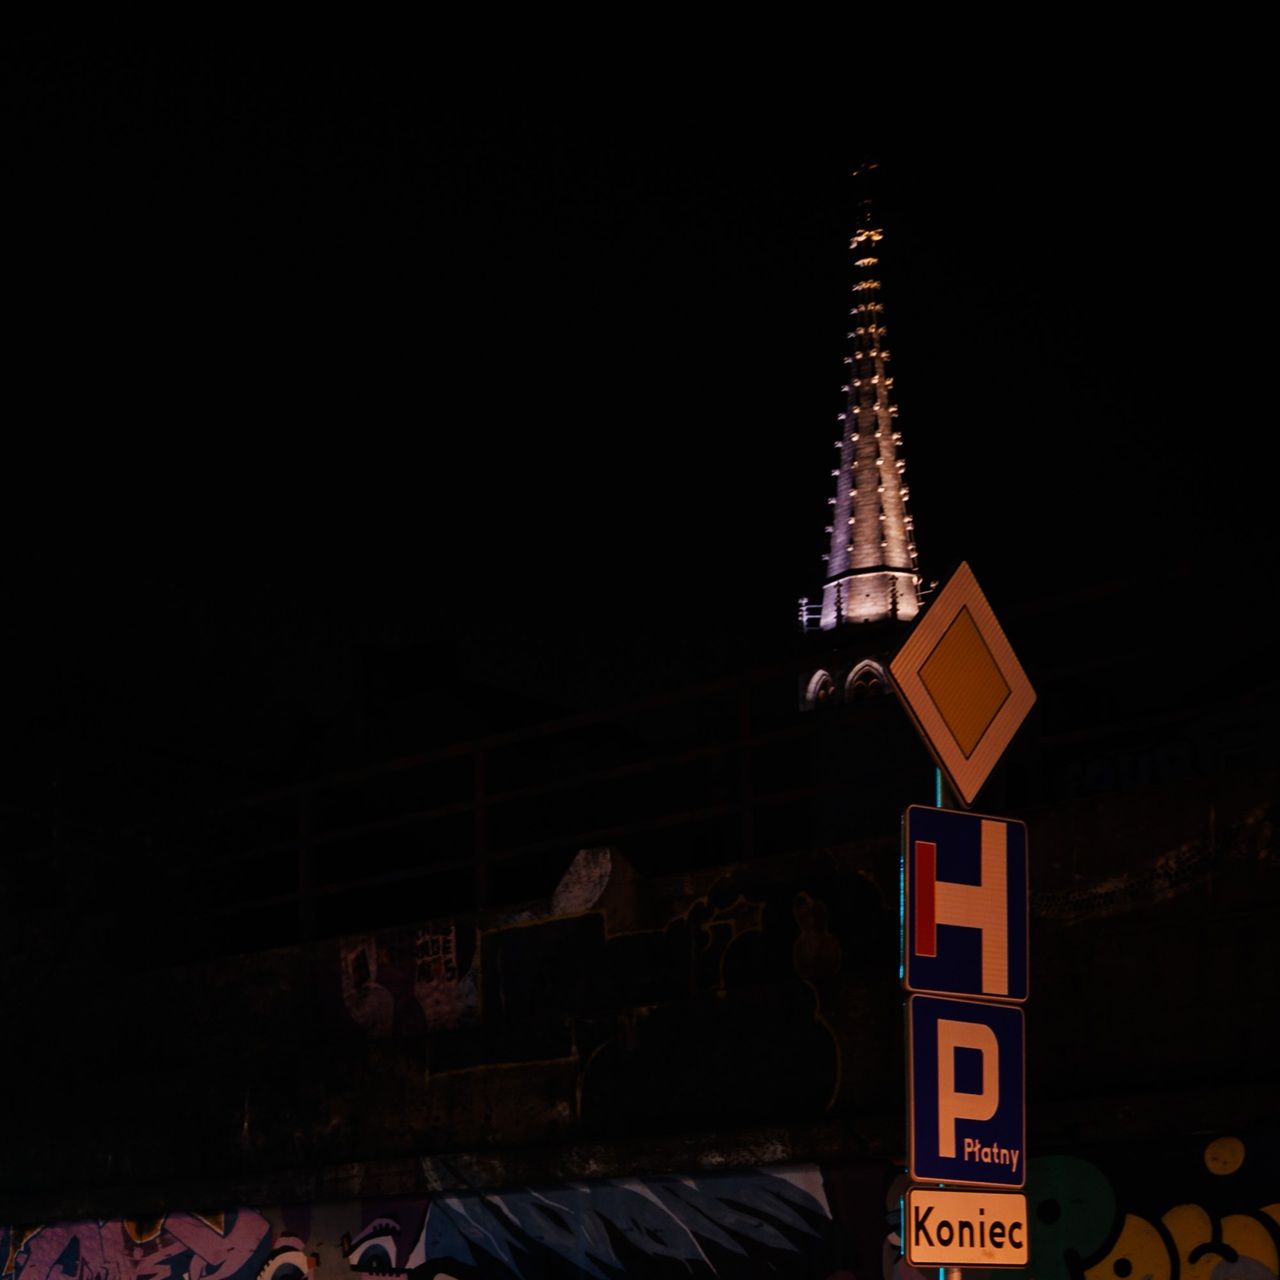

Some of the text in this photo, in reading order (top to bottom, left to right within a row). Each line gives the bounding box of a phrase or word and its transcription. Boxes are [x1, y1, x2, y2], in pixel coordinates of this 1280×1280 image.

[937, 1019, 999, 1158] P
[964, 1138, 1019, 1172] Płatny
[915, 1206, 1023, 1250] Koniec
